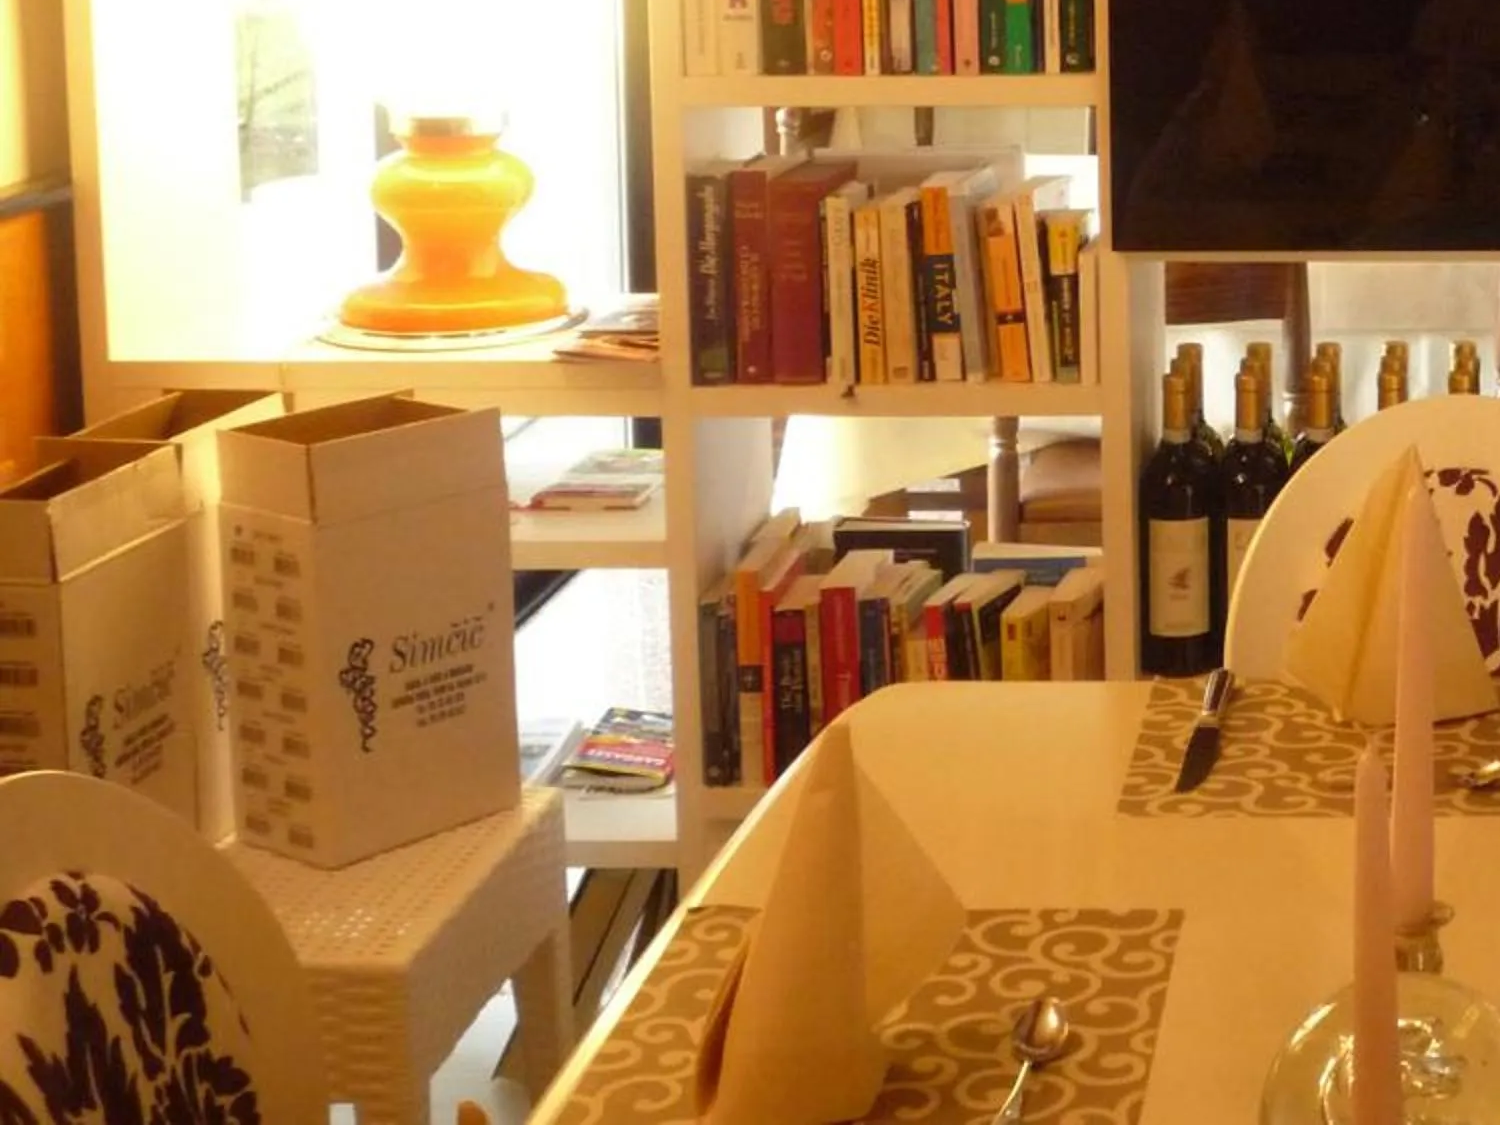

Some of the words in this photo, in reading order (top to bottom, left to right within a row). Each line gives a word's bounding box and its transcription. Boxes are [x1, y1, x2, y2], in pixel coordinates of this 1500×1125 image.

[858, 257, 881, 314] Klinik
[931, 262, 953, 325] ITALY
[862, 313, 881, 348] Die
[389, 613, 486, 673] Simčič
